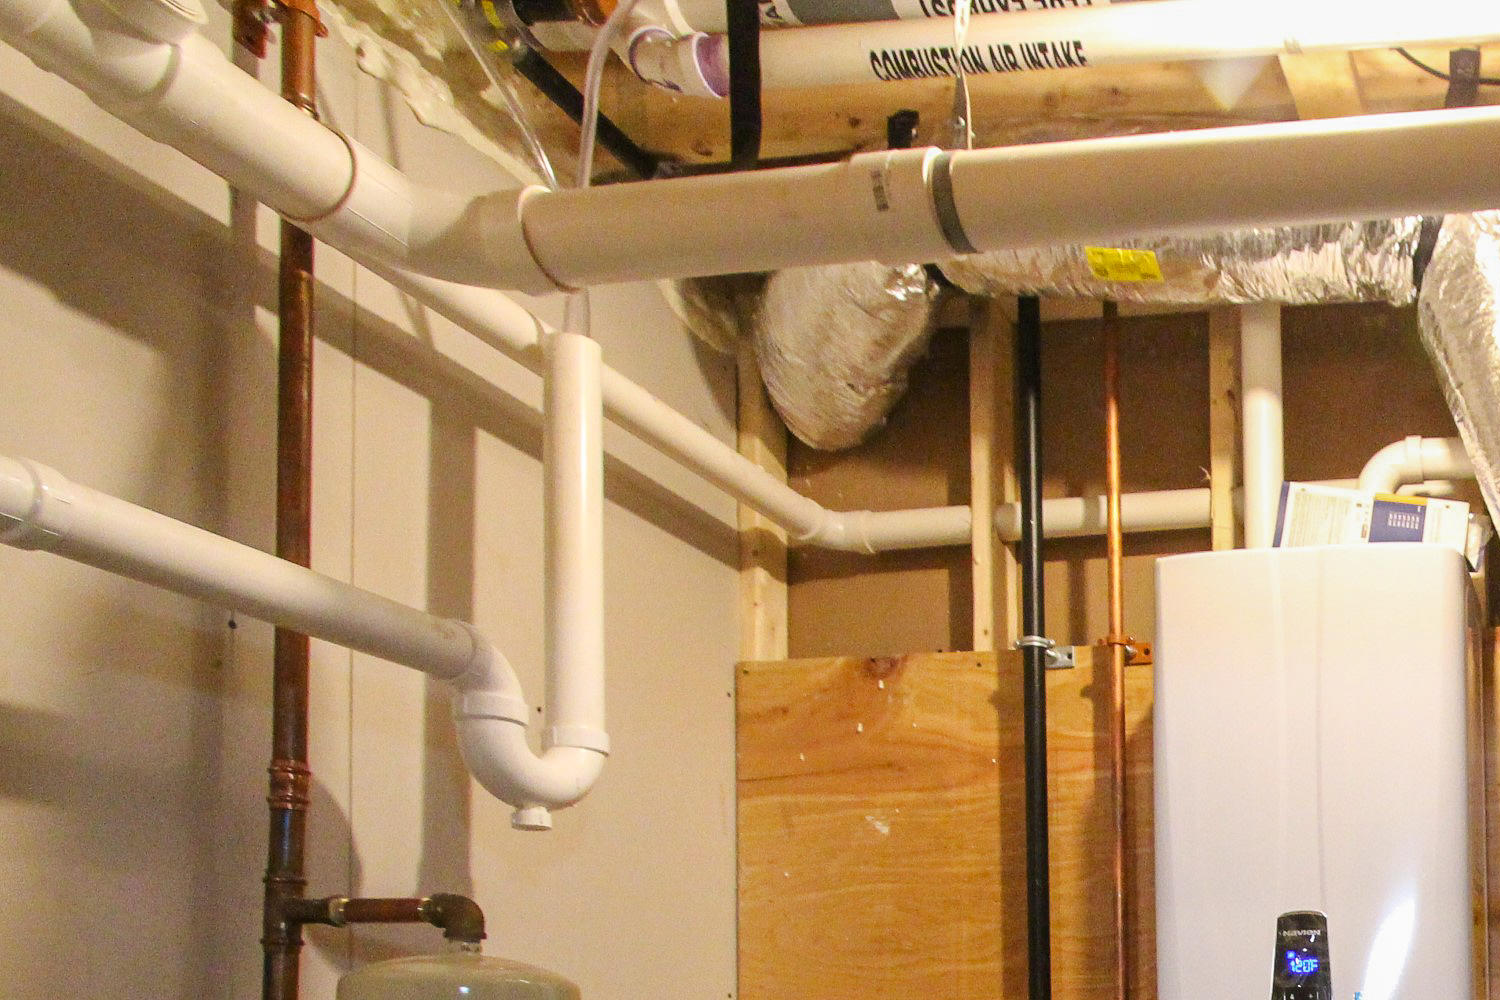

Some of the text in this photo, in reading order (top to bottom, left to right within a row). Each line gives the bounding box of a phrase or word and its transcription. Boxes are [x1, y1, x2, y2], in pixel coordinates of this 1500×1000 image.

[870, 40, 1087, 81] COMBUSTION AIR INTAKE
